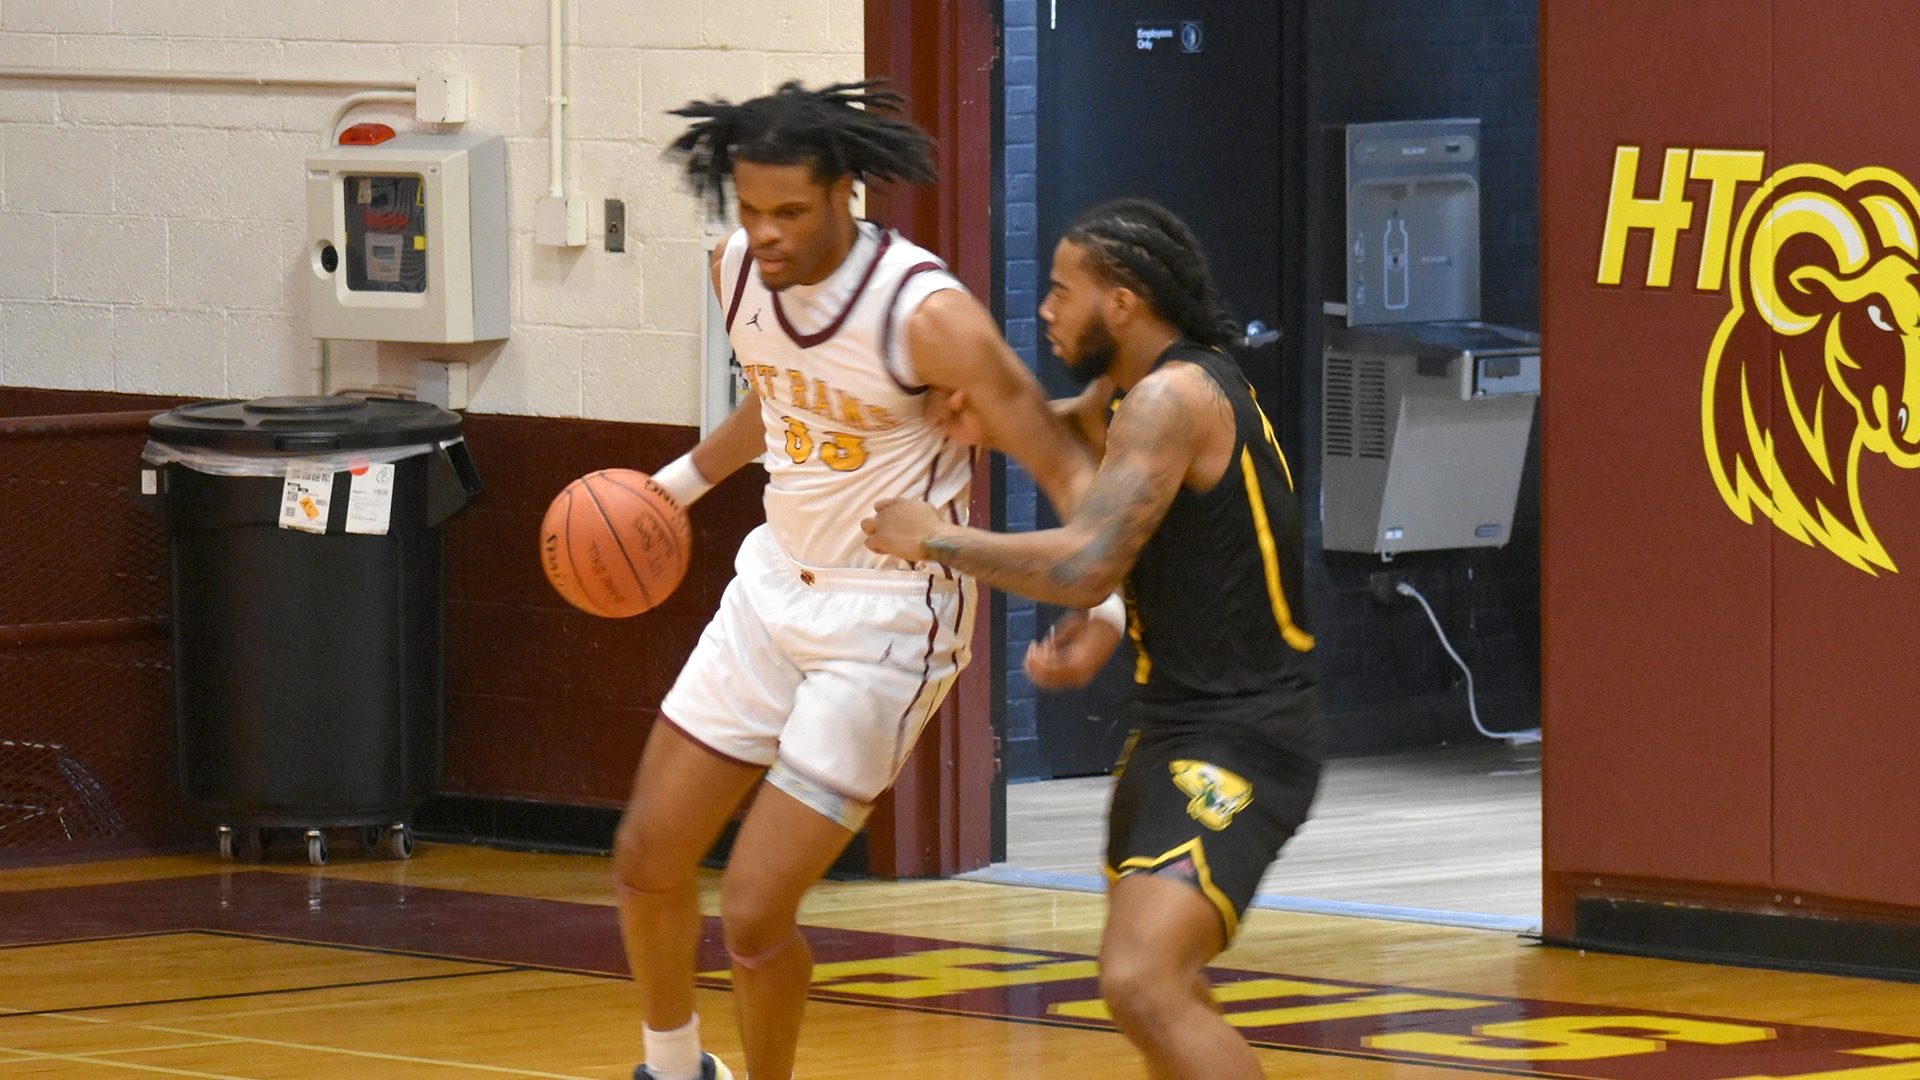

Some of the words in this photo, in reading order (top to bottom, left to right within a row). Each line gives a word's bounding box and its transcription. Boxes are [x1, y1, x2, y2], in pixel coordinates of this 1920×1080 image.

[1136, 29, 1174, 39] Employees
[1136, 39, 1154, 51] Only
[1597, 146, 1764, 290] HT
